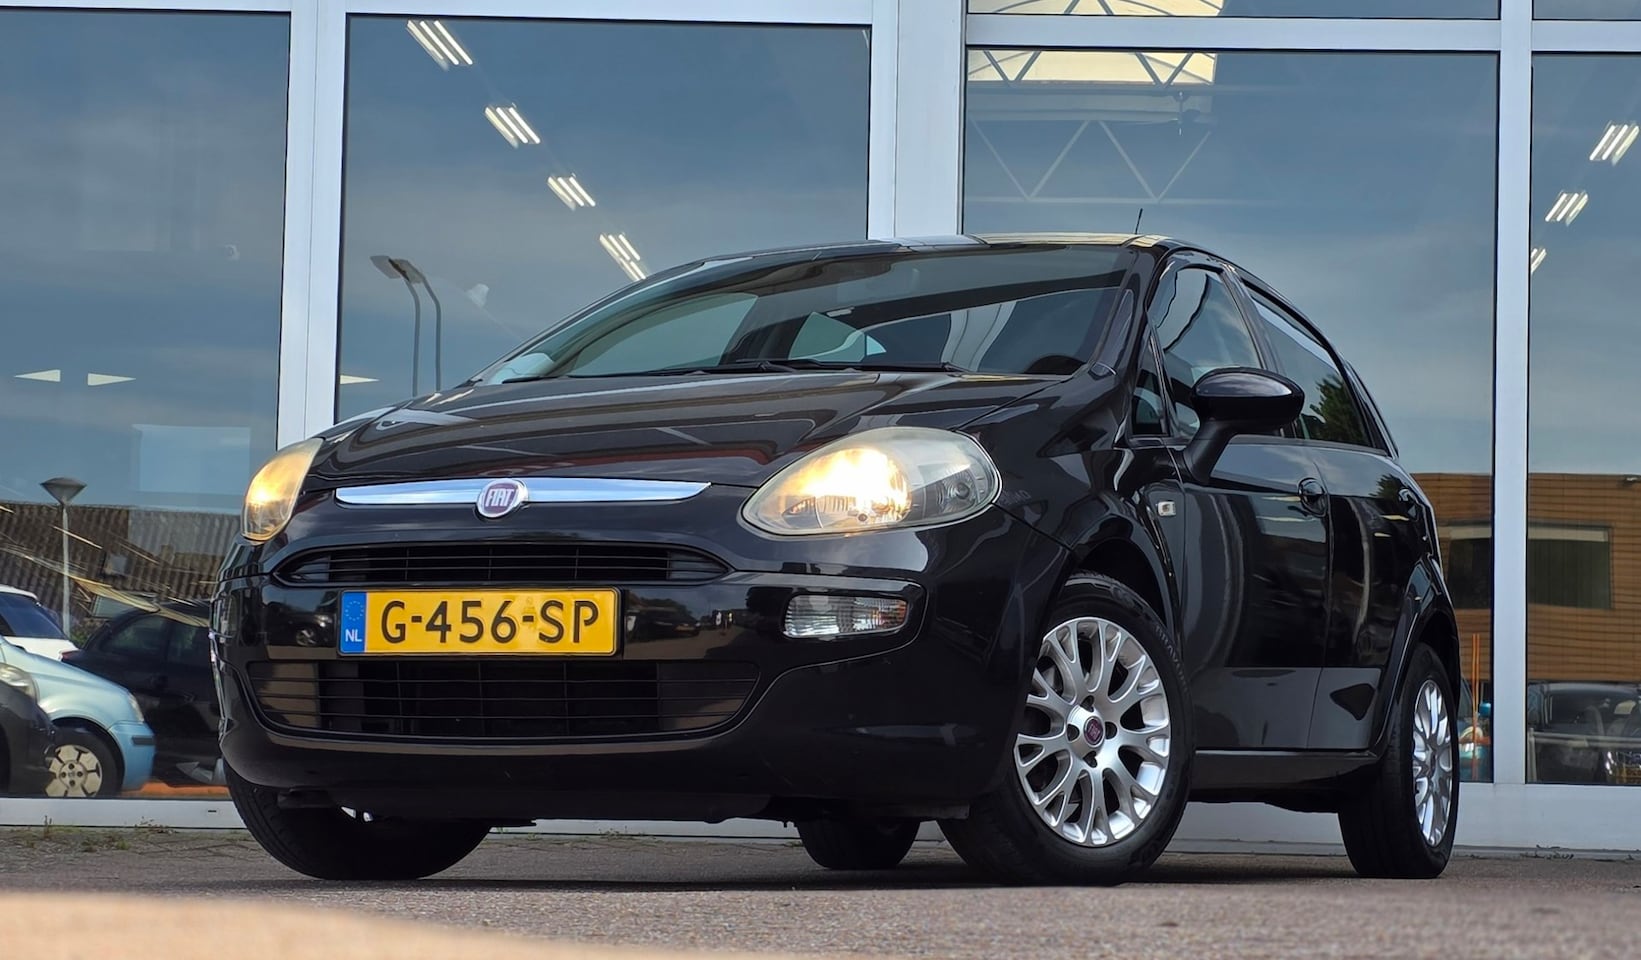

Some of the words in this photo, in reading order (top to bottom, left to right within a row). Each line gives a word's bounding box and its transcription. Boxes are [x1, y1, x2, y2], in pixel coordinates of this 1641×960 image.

[485, 488, 514, 507] FIAT
[381, 600, 599, 644] G-456-SP
[345, 629, 362, 642] NL
